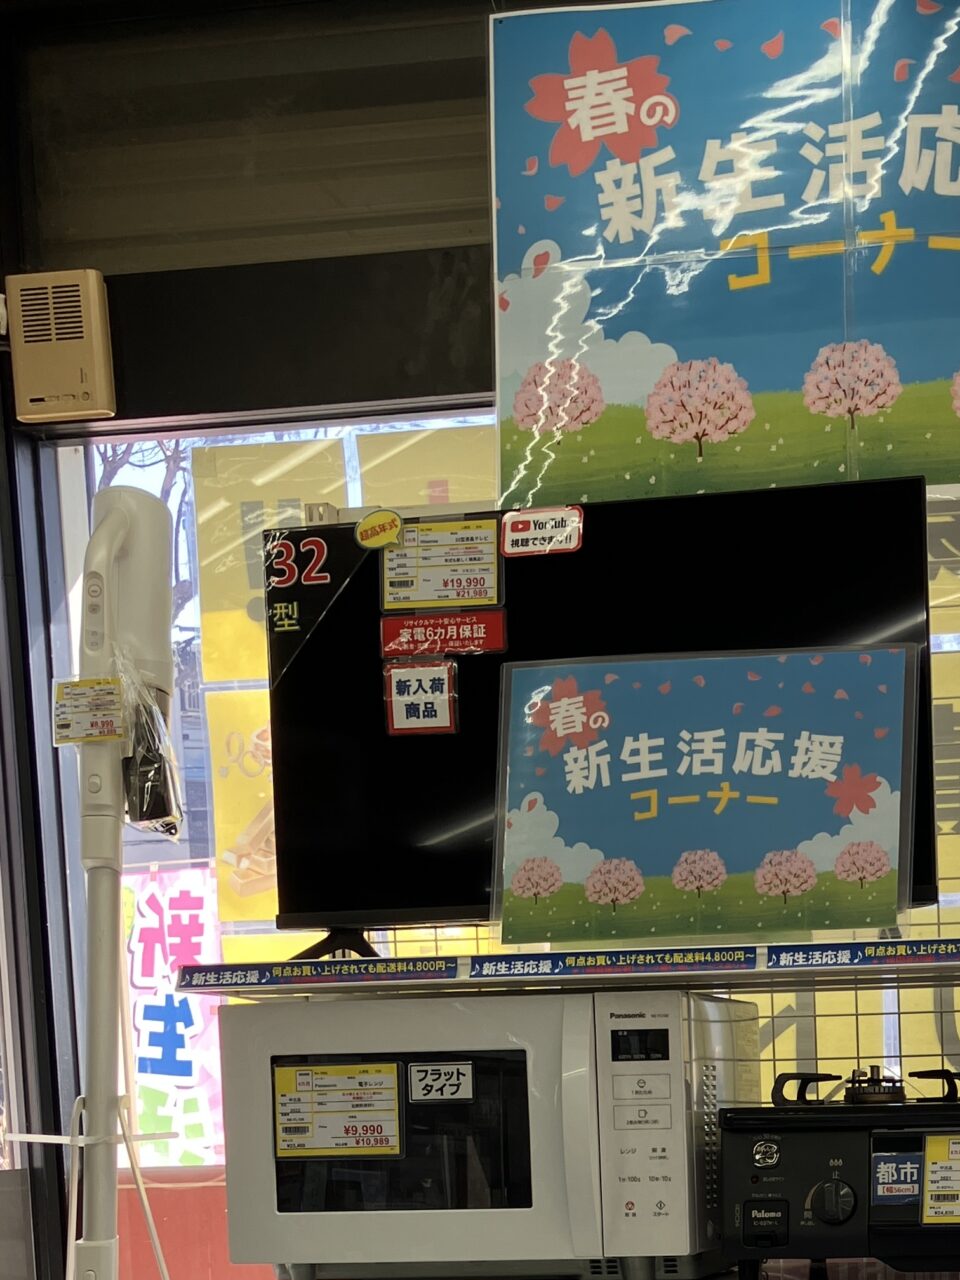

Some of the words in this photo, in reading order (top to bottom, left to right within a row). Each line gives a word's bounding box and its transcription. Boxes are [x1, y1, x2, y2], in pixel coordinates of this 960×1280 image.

[563, 65, 678, 142] 春の
[266, 536, 331, 588] 32
[442, 576, 486, 589] ¥19,990
[456, 590, 488, 599] ¥21,989
[272, 601, 300, 633] 型
[400, 624, 486, 641] 家電6カ月保証
[396, 677, 445, 696] 新入荷
[405, 702, 437, 720] 商品
[549, 696, 610, 737] 春の
[563, 727, 844, 795] 新生活応援
[631, 781, 778, 821] コーナー
[779, 950, 851, 966] 新生活応援
[482, 960, 552, 975] 新生活応援
[191, 970, 259, 985] 新生活応援
[609, 1012, 647, 1020] Panasonic
[416, 1068, 466, 1082] フラット
[421, 1083, 462, 1096] タイプ
[343, 1125, 383, 1136] ¥9,990
[355, 1138, 390, 1146] ¥10,989
[876, 1161, 919, 1183] 都市
[752, 1210, 782, 1218] Paloma
